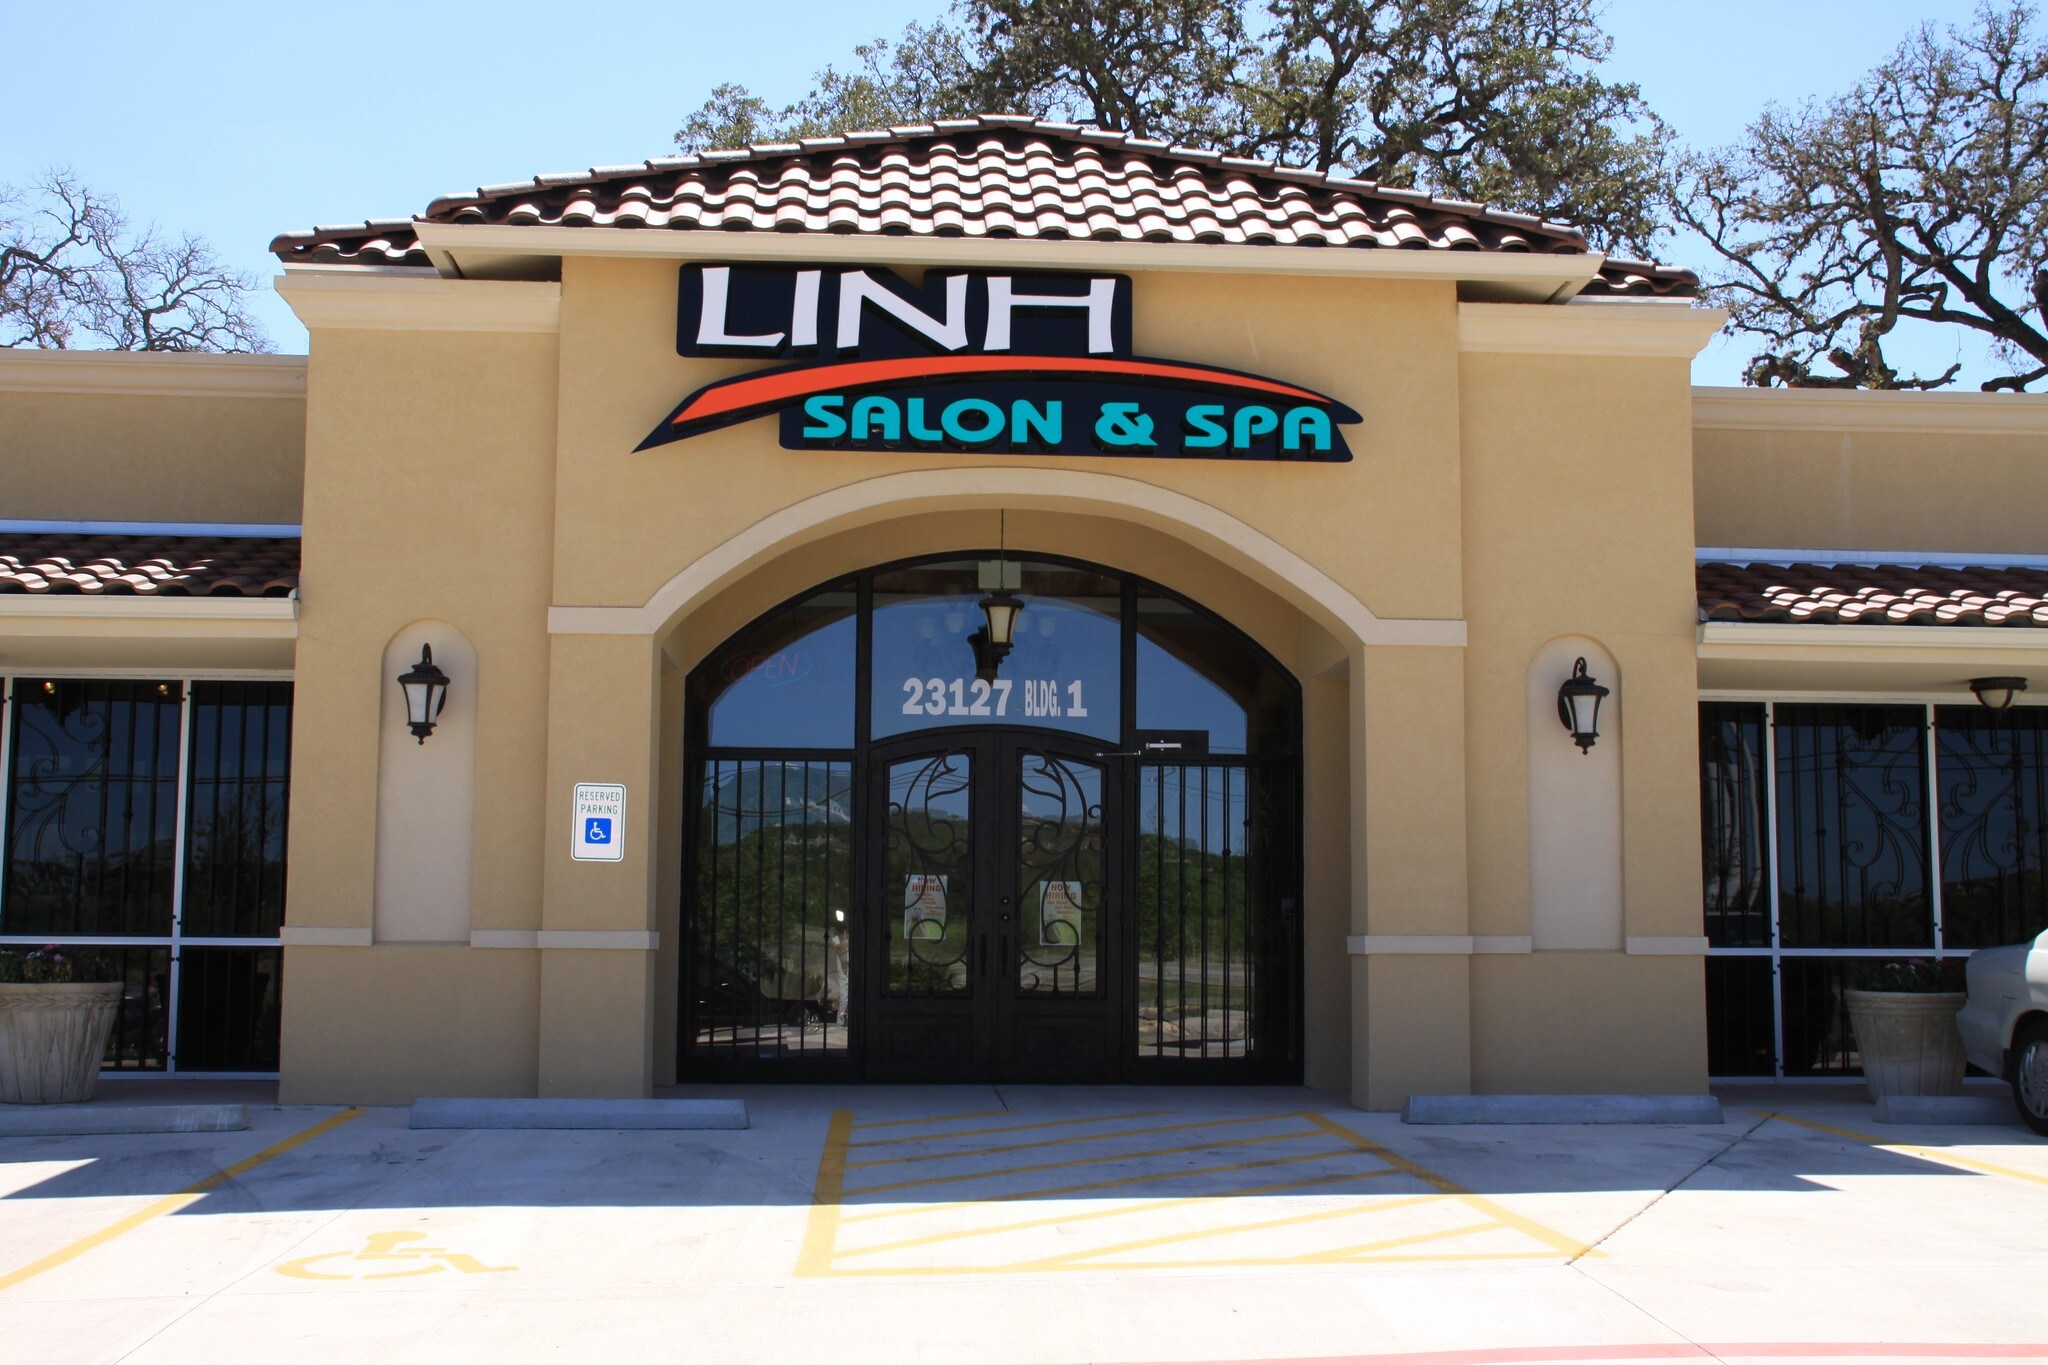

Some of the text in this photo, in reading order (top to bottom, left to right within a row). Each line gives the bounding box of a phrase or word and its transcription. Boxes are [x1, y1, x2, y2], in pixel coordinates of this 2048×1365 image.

[695, 266, 1116, 354] LINH
[802, 395, 1332, 451] SALON & SPA
[730, 653, 800, 682] OPEN
[902, 677, 1088, 718] 23127 BLDG. 1
[579, 791, 620, 802] RESERVED
[580, 804, 618, 815] PARKING
